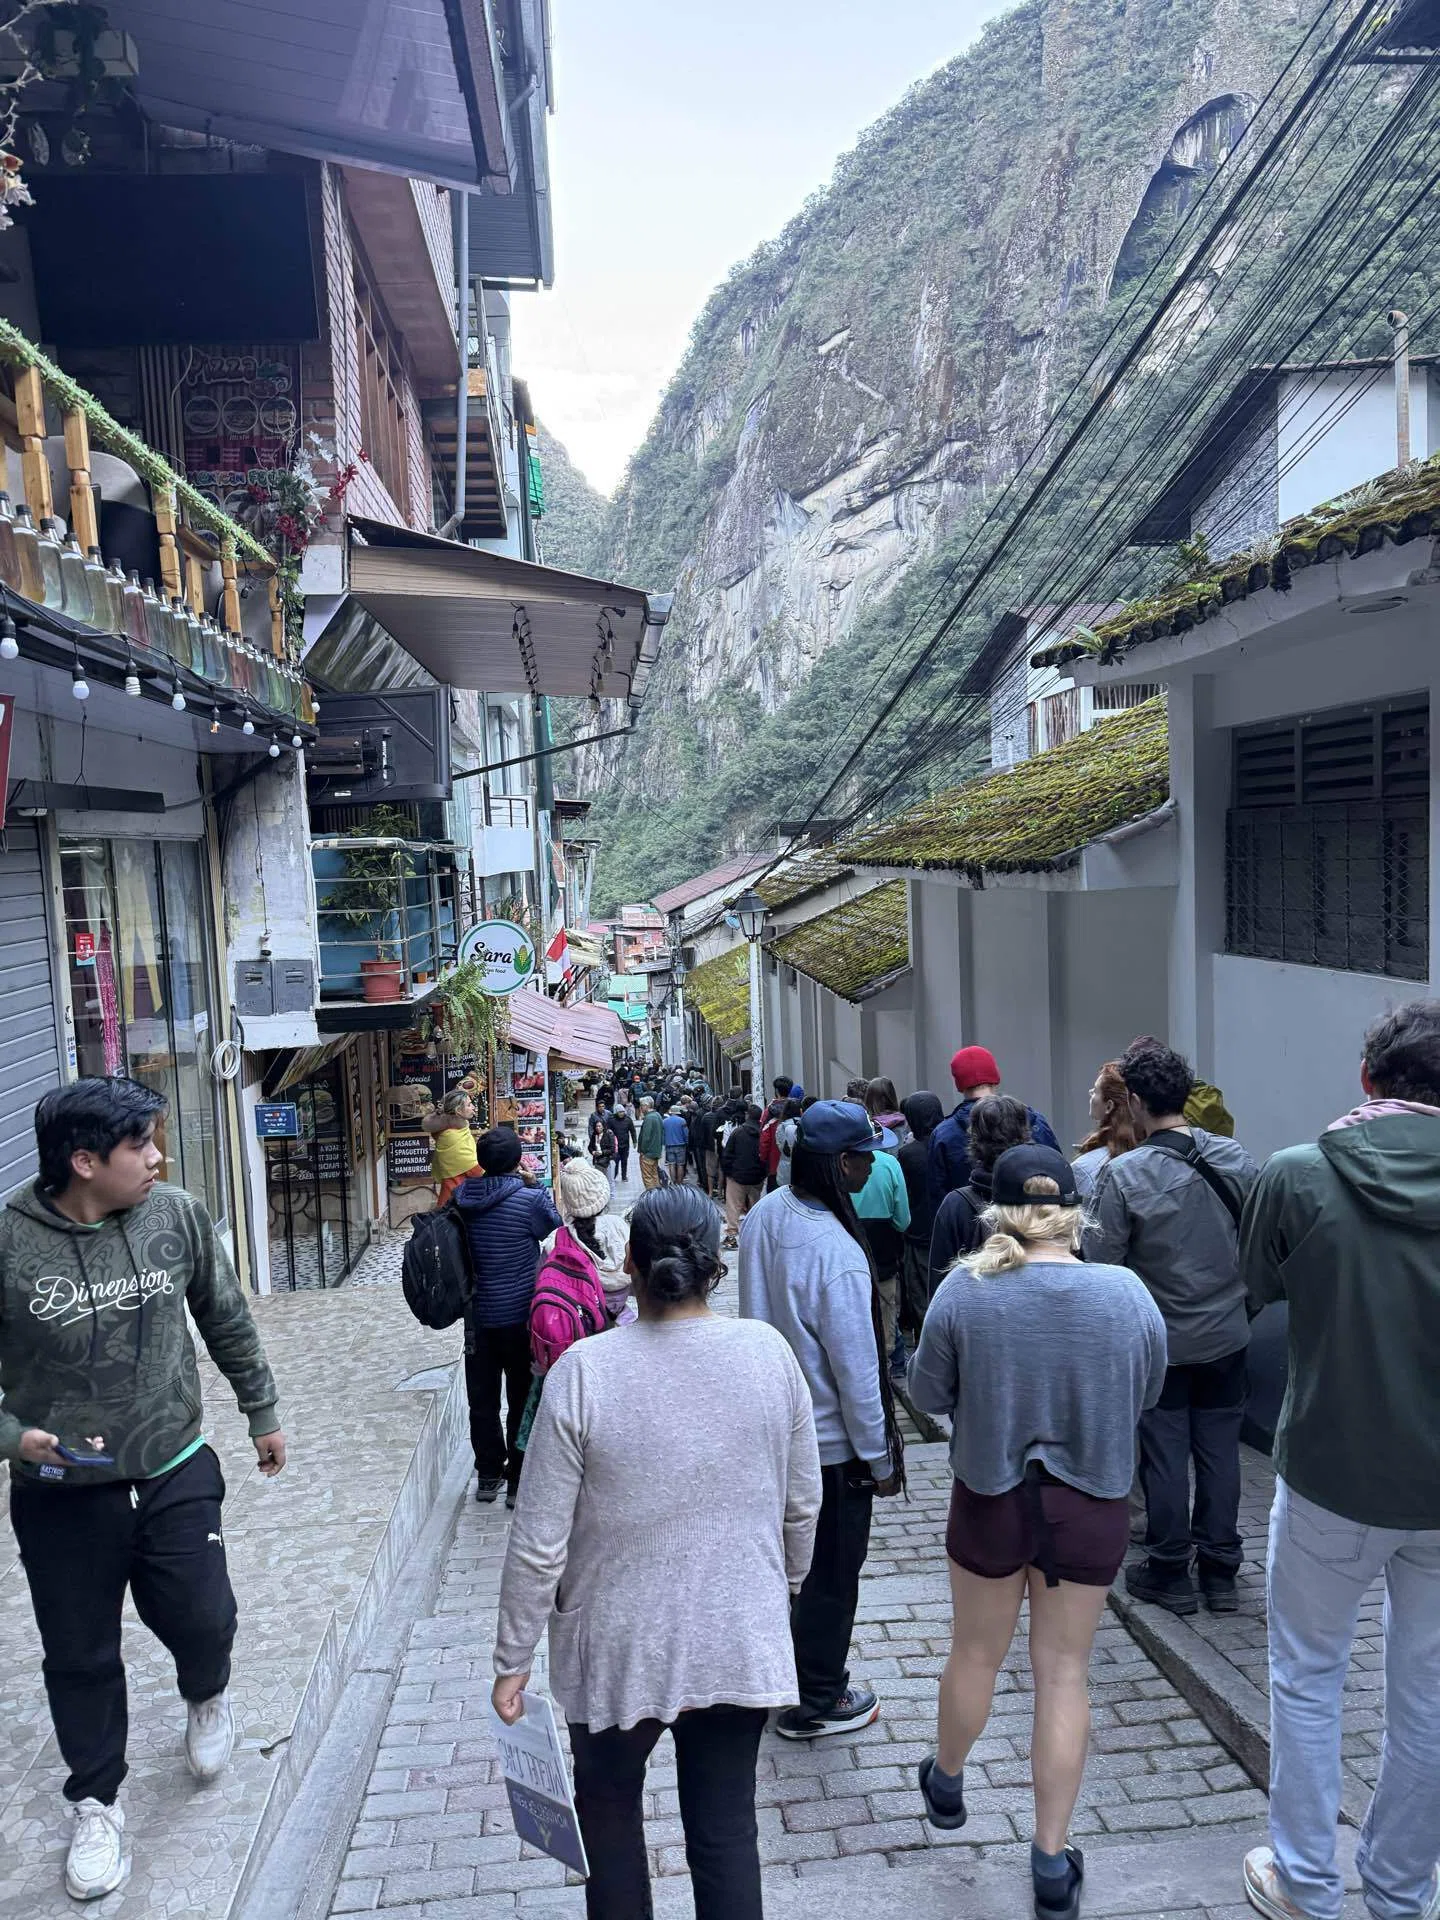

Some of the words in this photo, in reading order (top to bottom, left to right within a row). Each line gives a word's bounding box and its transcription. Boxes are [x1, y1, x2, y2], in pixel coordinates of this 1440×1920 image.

[182, 348, 257, 386] Pizza
[470, 941, 512, 964] Sara
[395, 1139, 420, 1147] LASAGNA
[395, 1148, 428, 1156] SPAGUETTIS
[395, 1156, 425, 1165] EMPANDAS
[29, 1268, 174, 1326] Dimension
